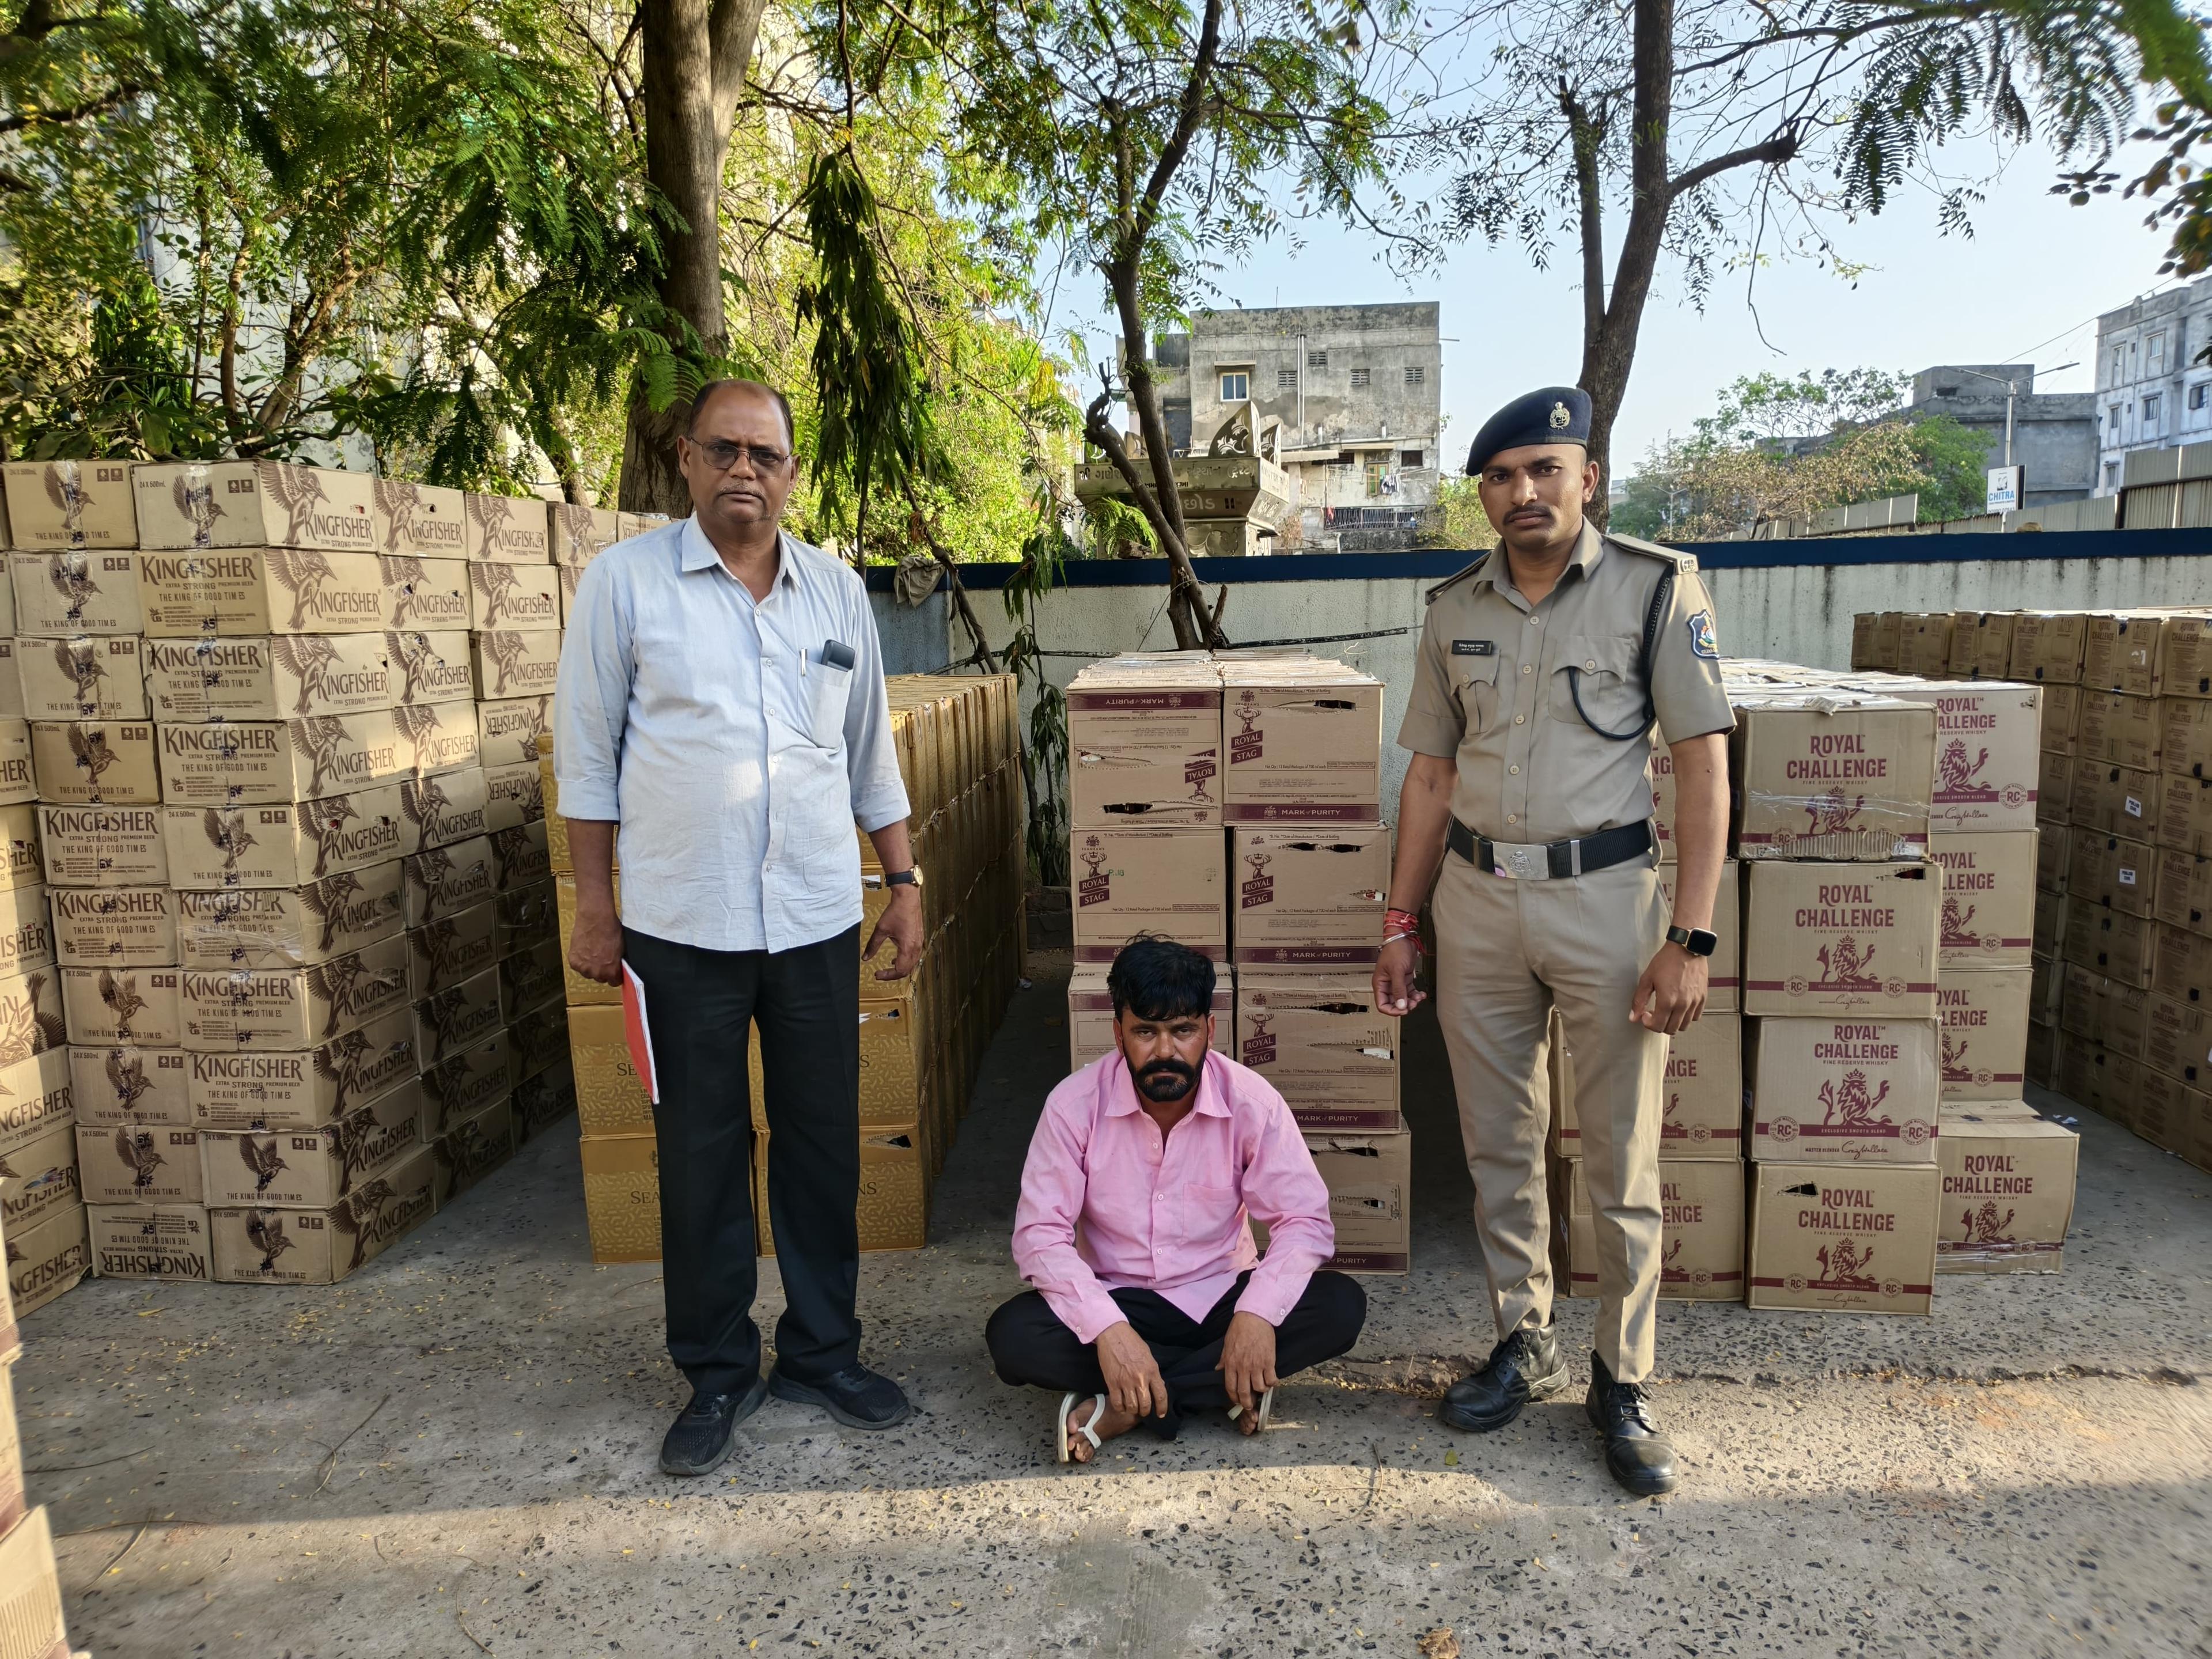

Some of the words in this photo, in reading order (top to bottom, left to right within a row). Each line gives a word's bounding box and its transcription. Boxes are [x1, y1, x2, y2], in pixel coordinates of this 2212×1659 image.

[1988, 490, 2014, 501] CHITRA
[304, 509, 374, 543] KINGFISHER
[402, 517, 464, 544] KINGFISHER
[331, 540, 351, 548] STRONG
[309, 588, 382, 619] KINGFISHER
[408, 593, 468, 619] KINGFISHER
[501, 595, 556, 619] KINGFISHER
[41, 620, 51, 628] THE
[54, 620, 69, 628] KING
[338, 616, 358, 624] STRONG
[2017, 626, 2039, 635] CHALLENGE
[2172, 632, 2200, 643] CHALLENGE
[415, 665, 472, 694] KINGFISHER
[509, 661, 558, 686] KINGFISHER
[315, 671, 389, 702] KINGFISHER
[344, 698, 366, 706] STRONG
[484, 707, 536, 737] KINGFISHER
[164, 727, 279, 756] KINGFISHER
[1234, 733, 1260, 746] ROYAL
[1810, 734, 1865, 758] ROYAL
[424, 734, 478, 764] KINGFISHER
[1236, 749, 1257, 761] STAG
[226, 763, 244, 771] GOOD
[327, 747, 397, 782] KINGFISHER
[1786, 758, 1887, 779] CHALLENGE
[354, 775, 375, 785] STRONG
[1187, 767, 1213, 781] ROYAL
[2007, 791, 2021, 804] RC
[45, 809, 159, 838] KINGFISHER
[430, 809, 486, 842] KINGFISHER
[330, 821, 401, 861] KINGFISHER
[358, 850, 378, 861] STRONG
[1082, 878, 1107, 889] ROYAL
[1245, 879, 1271, 891] ROYAL
[1084, 893, 1105, 905] STAG
[1247, 895, 1268, 906] STAG
[1819, 885, 1872, 907] ROYAL
[1795, 908, 1895, 927] CHALLENGE
[88, 926, 104, 934] KING
[116, 926, 133, 934] GOOD
[1986, 938, 1996, 949] RC
[1791, 982, 1802, 993] RC
[1889, 983, 1900, 993] RC
[1246, 1036, 1274, 1050] ROYAL
[1814, 1043, 1898, 1059] CHALLENGE
[1248, 1053, 1270, 1065] STAG
[194, 1055, 305, 1083] KINGFISHER
[1978, 1074, 1988, 1084] RC
[222, 1090, 238, 1099] KING
[1695, 1129, 1706, 1139] RC
[1777, 1124, 1791, 1137] RC
[1908, 1127, 1923, 1140] RC
[354, 1116, 416, 1173] KINGFISHER
[1965, 1155, 2014, 1175] ROYAL
[1942, 1176, 2033, 1194] CHALLENGE
[1821, 1188, 1874, 1210] ROYAL
[1798, 1210, 1895, 1232] CHALLENGE
[151, 1237, 158, 1245] OF
[178, 1238, 190, 1246] THE
[1696, 1273, 1707, 1283] RC
[1790, 1279, 1801, 1289] RC
[1885, 1284, 1897, 1294] RC
